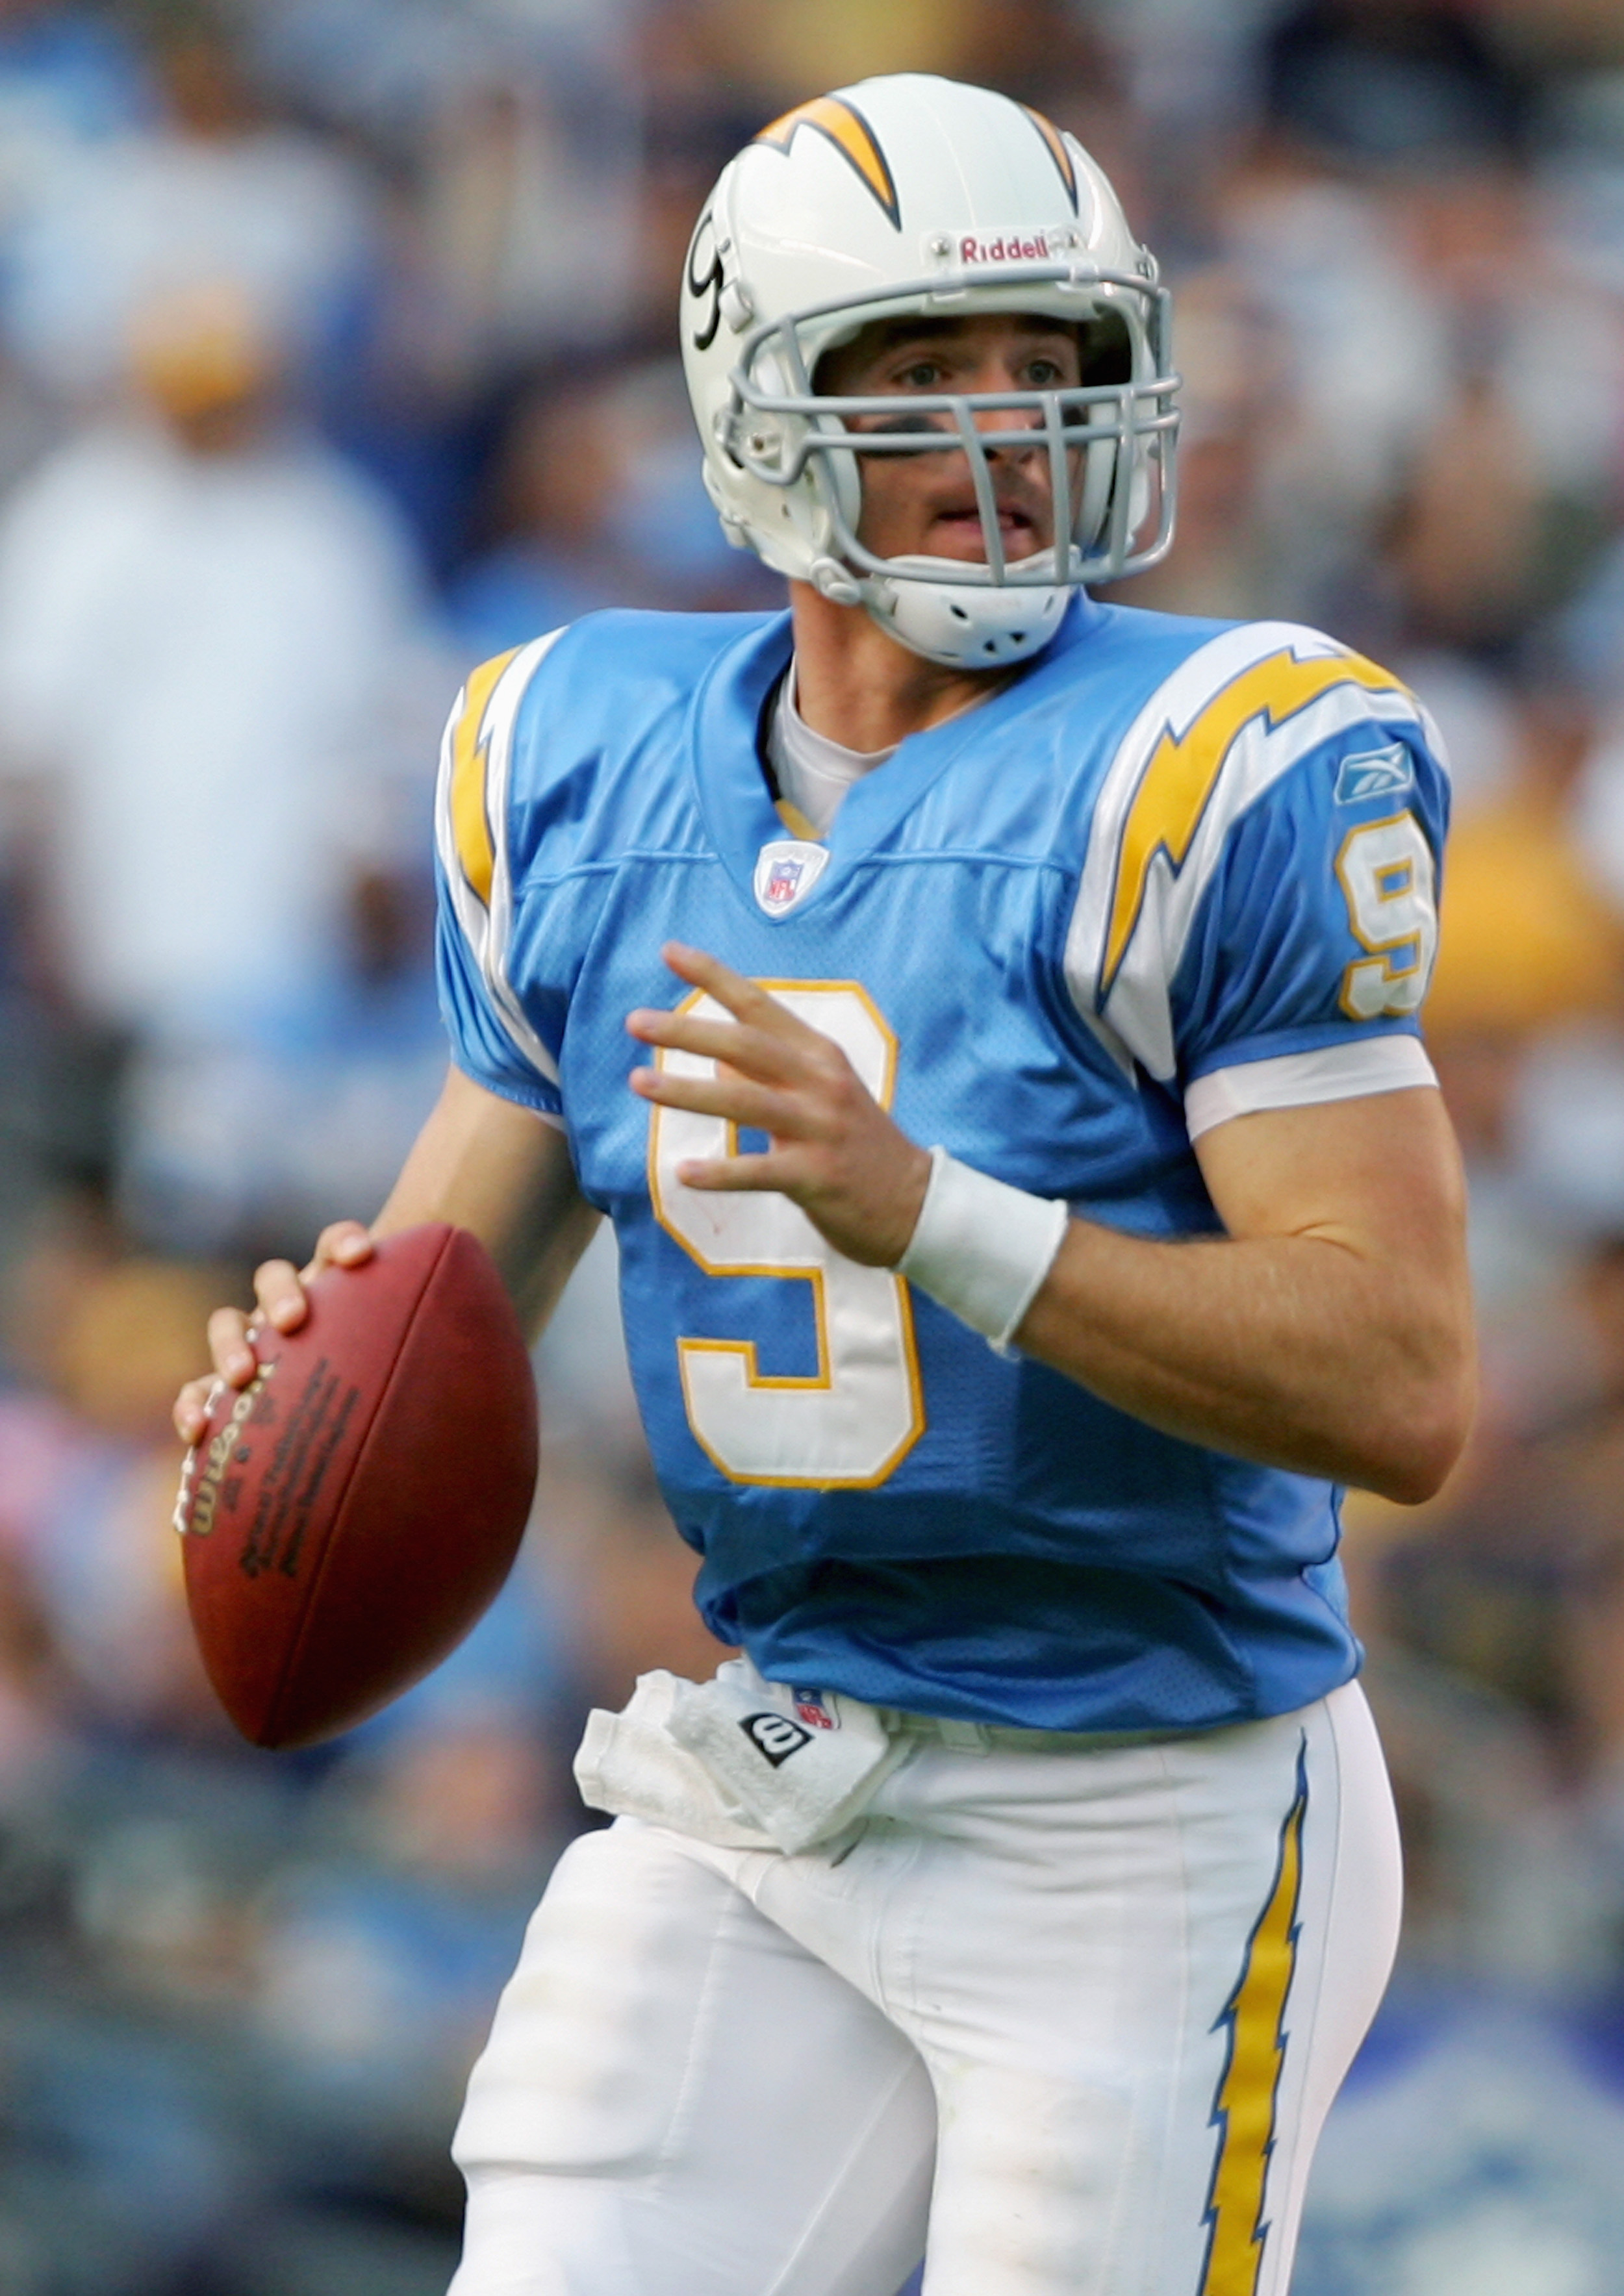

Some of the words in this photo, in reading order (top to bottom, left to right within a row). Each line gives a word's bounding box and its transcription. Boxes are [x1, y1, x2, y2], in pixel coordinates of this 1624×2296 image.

[960, 236, 1050, 264] Riddell
[1334, 808, 1438, 1022] 9
[648, 978, 926, 1491] 9
